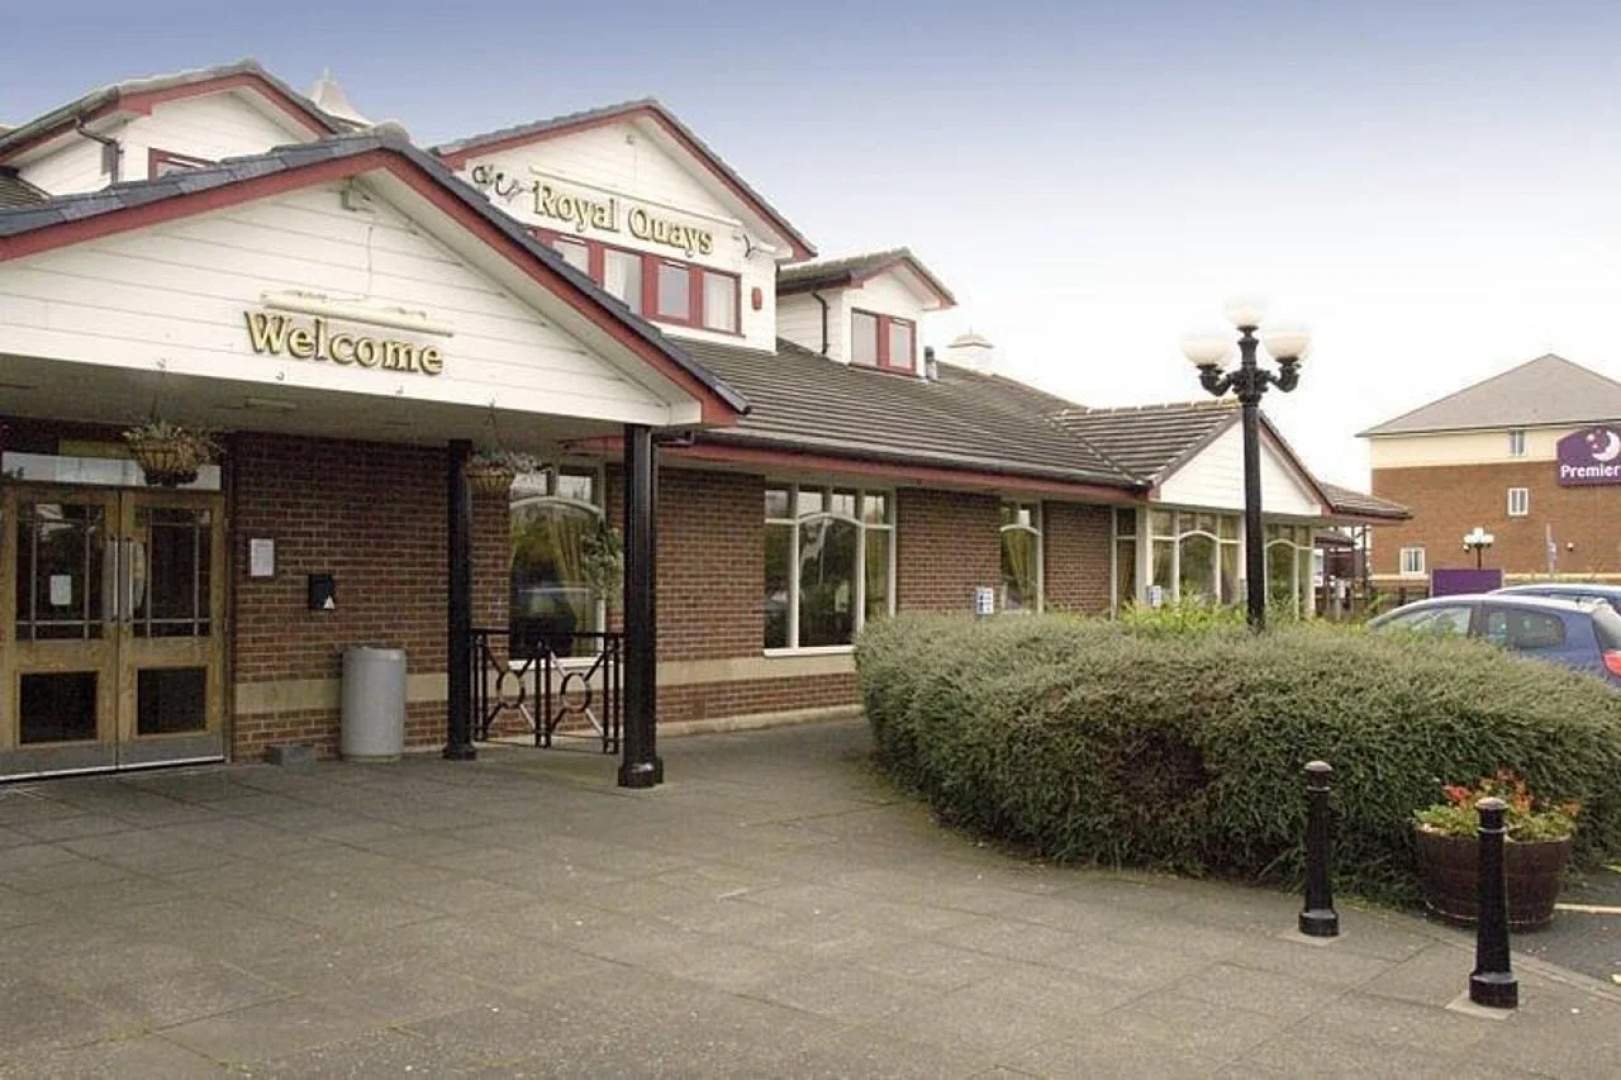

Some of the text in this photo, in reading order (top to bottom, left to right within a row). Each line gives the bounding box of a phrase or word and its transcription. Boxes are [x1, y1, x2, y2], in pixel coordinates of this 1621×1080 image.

[532, 180, 713, 257] Royal Quays
[244, 311, 443, 375] Welcome
[1561, 463, 1621, 478] Premier
